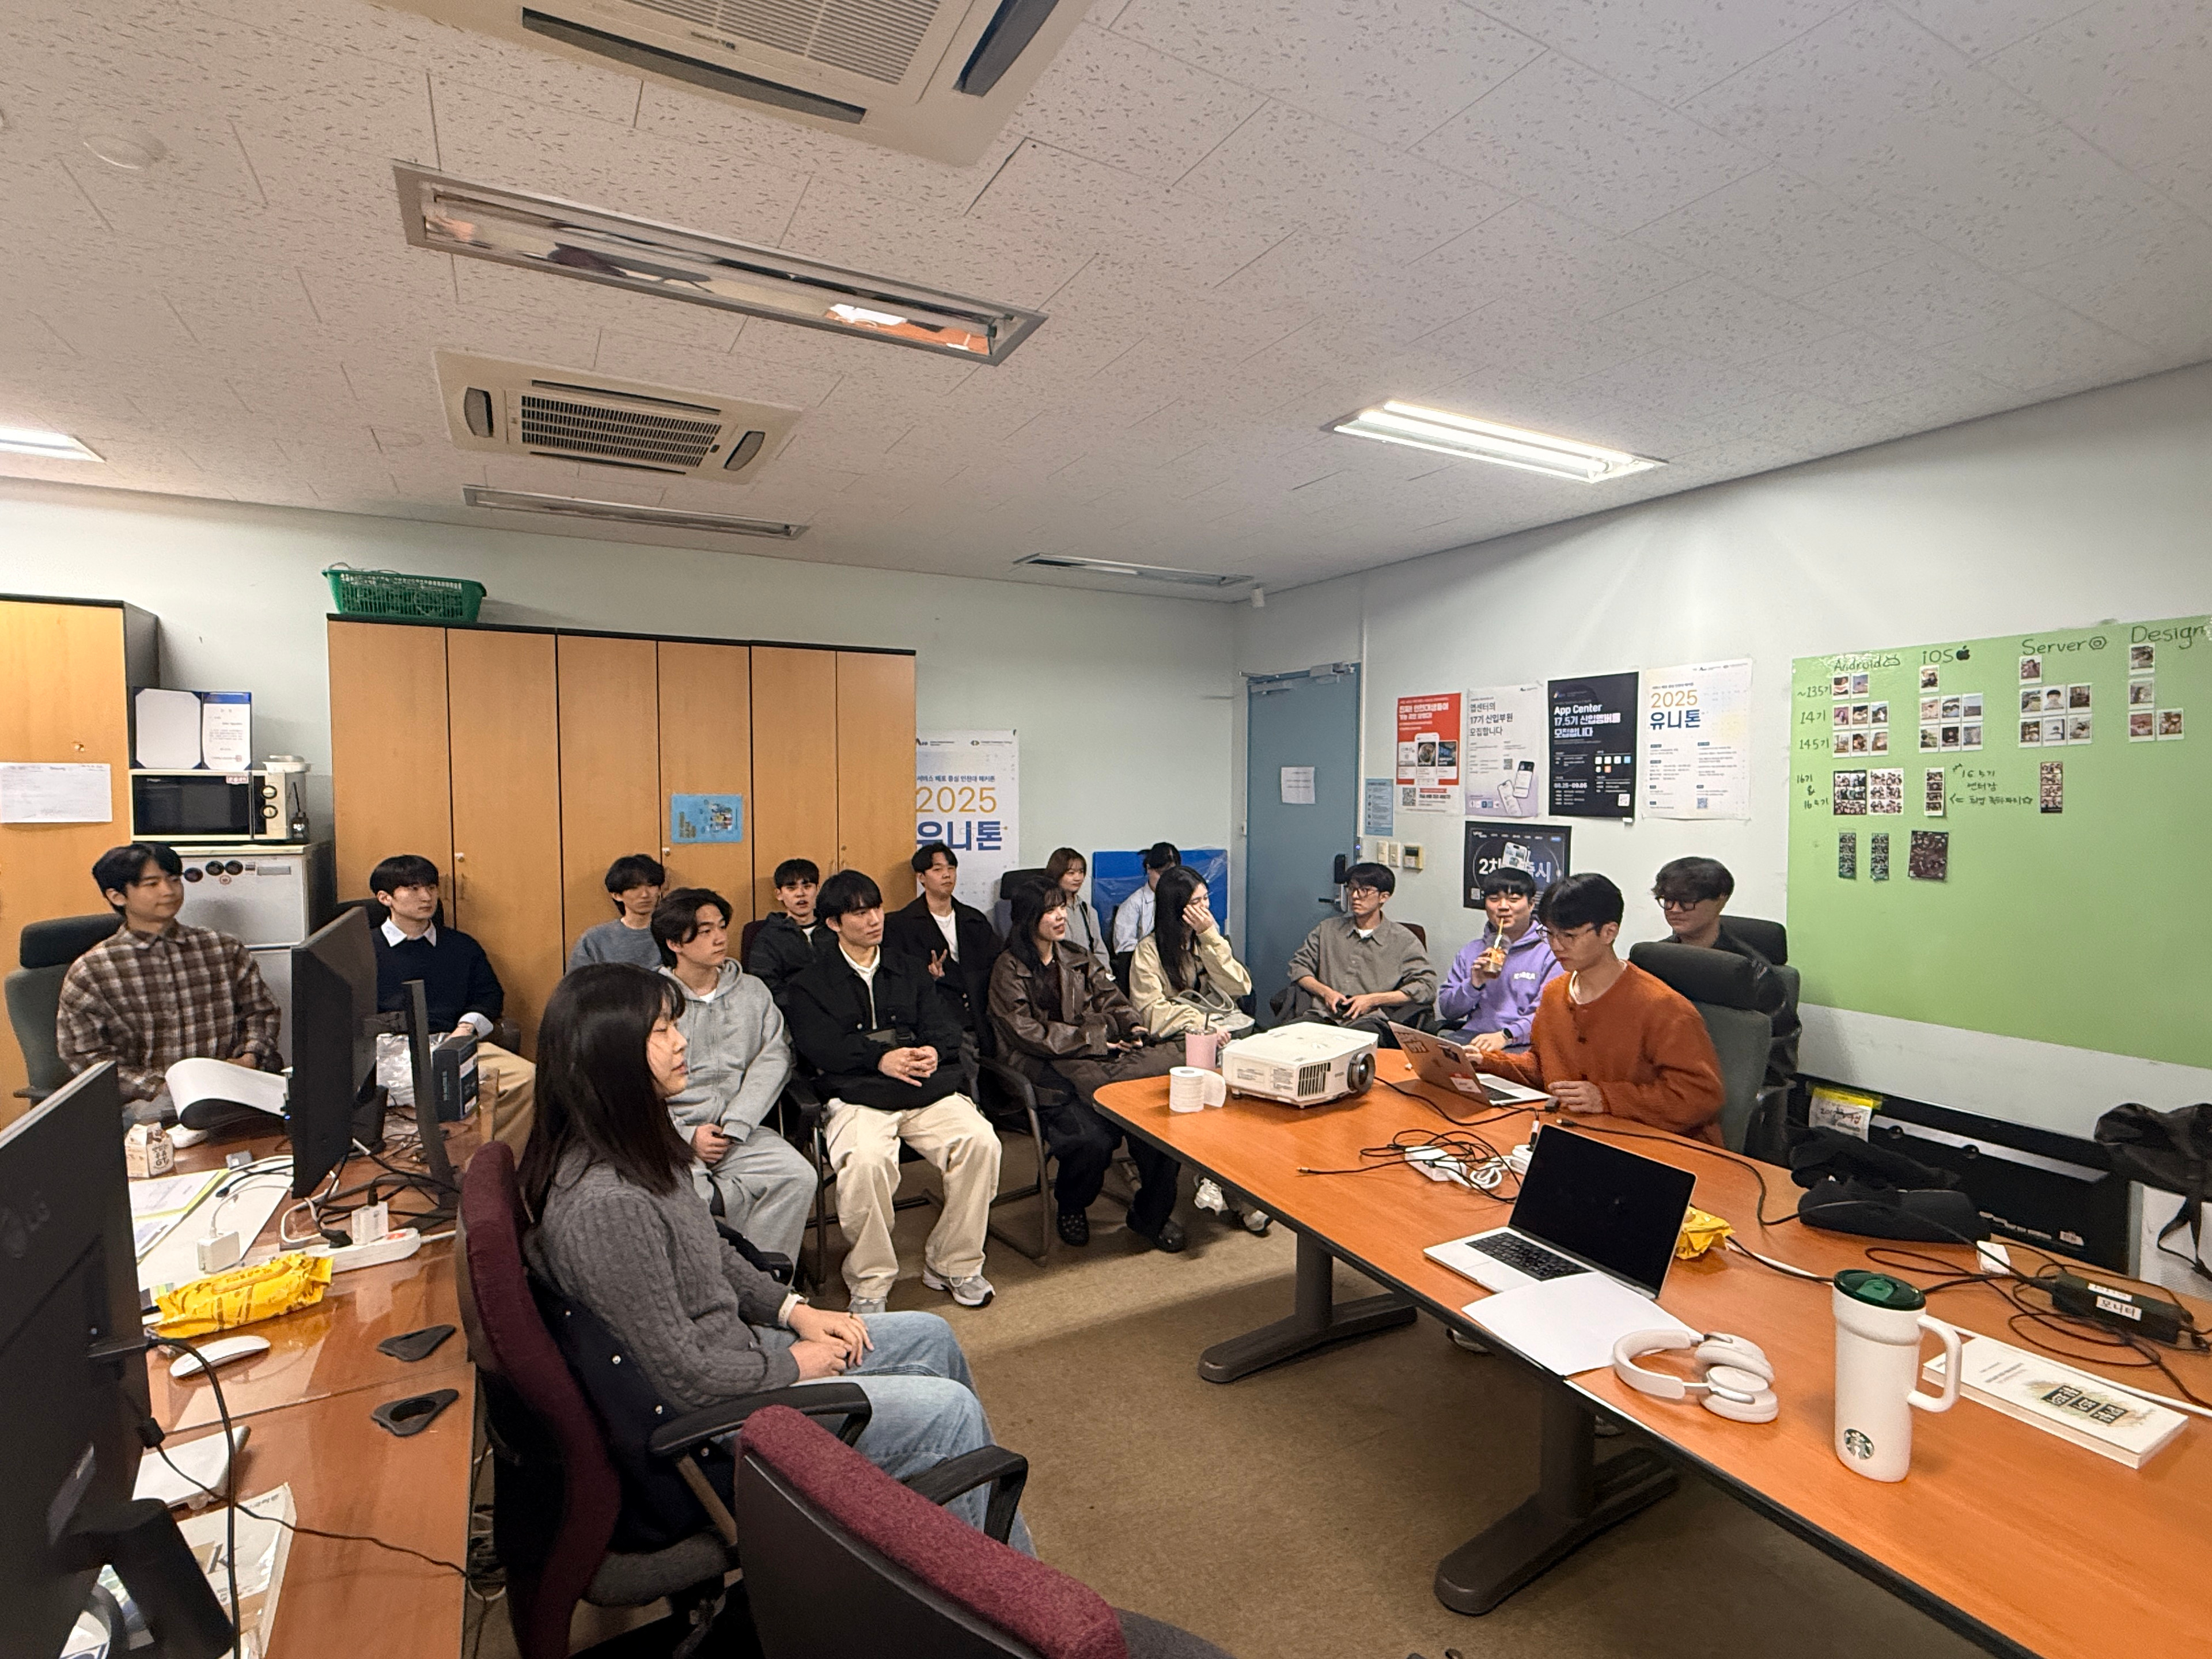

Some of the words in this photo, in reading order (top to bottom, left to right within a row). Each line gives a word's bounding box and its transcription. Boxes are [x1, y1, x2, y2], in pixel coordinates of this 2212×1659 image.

[2131, 625, 2205, 649] Design
[2022, 639, 2086, 655] Server
[1834, 656, 1881, 671] Android
[1922, 649, 1953, 664] iOS
[1651, 690, 1697, 708] 2025
[1470, 702, 1495, 713] 앱센터의
[1554, 706, 1571, 717] App
[1573, 703, 1603, 714] Center
[1470, 715, 1484, 724] 17기
[1486, 713, 1513, 724] 신입부원
[1555, 716, 1578, 726] 17.5기
[1650, 709, 1700, 730] 유니톤
[1800, 710, 1825, 724] 14기
[1469, 726, 1502, 736] 모집합니다
[1554, 727, 1593, 738] 모집합니다
[916, 786, 997, 813] 2025
